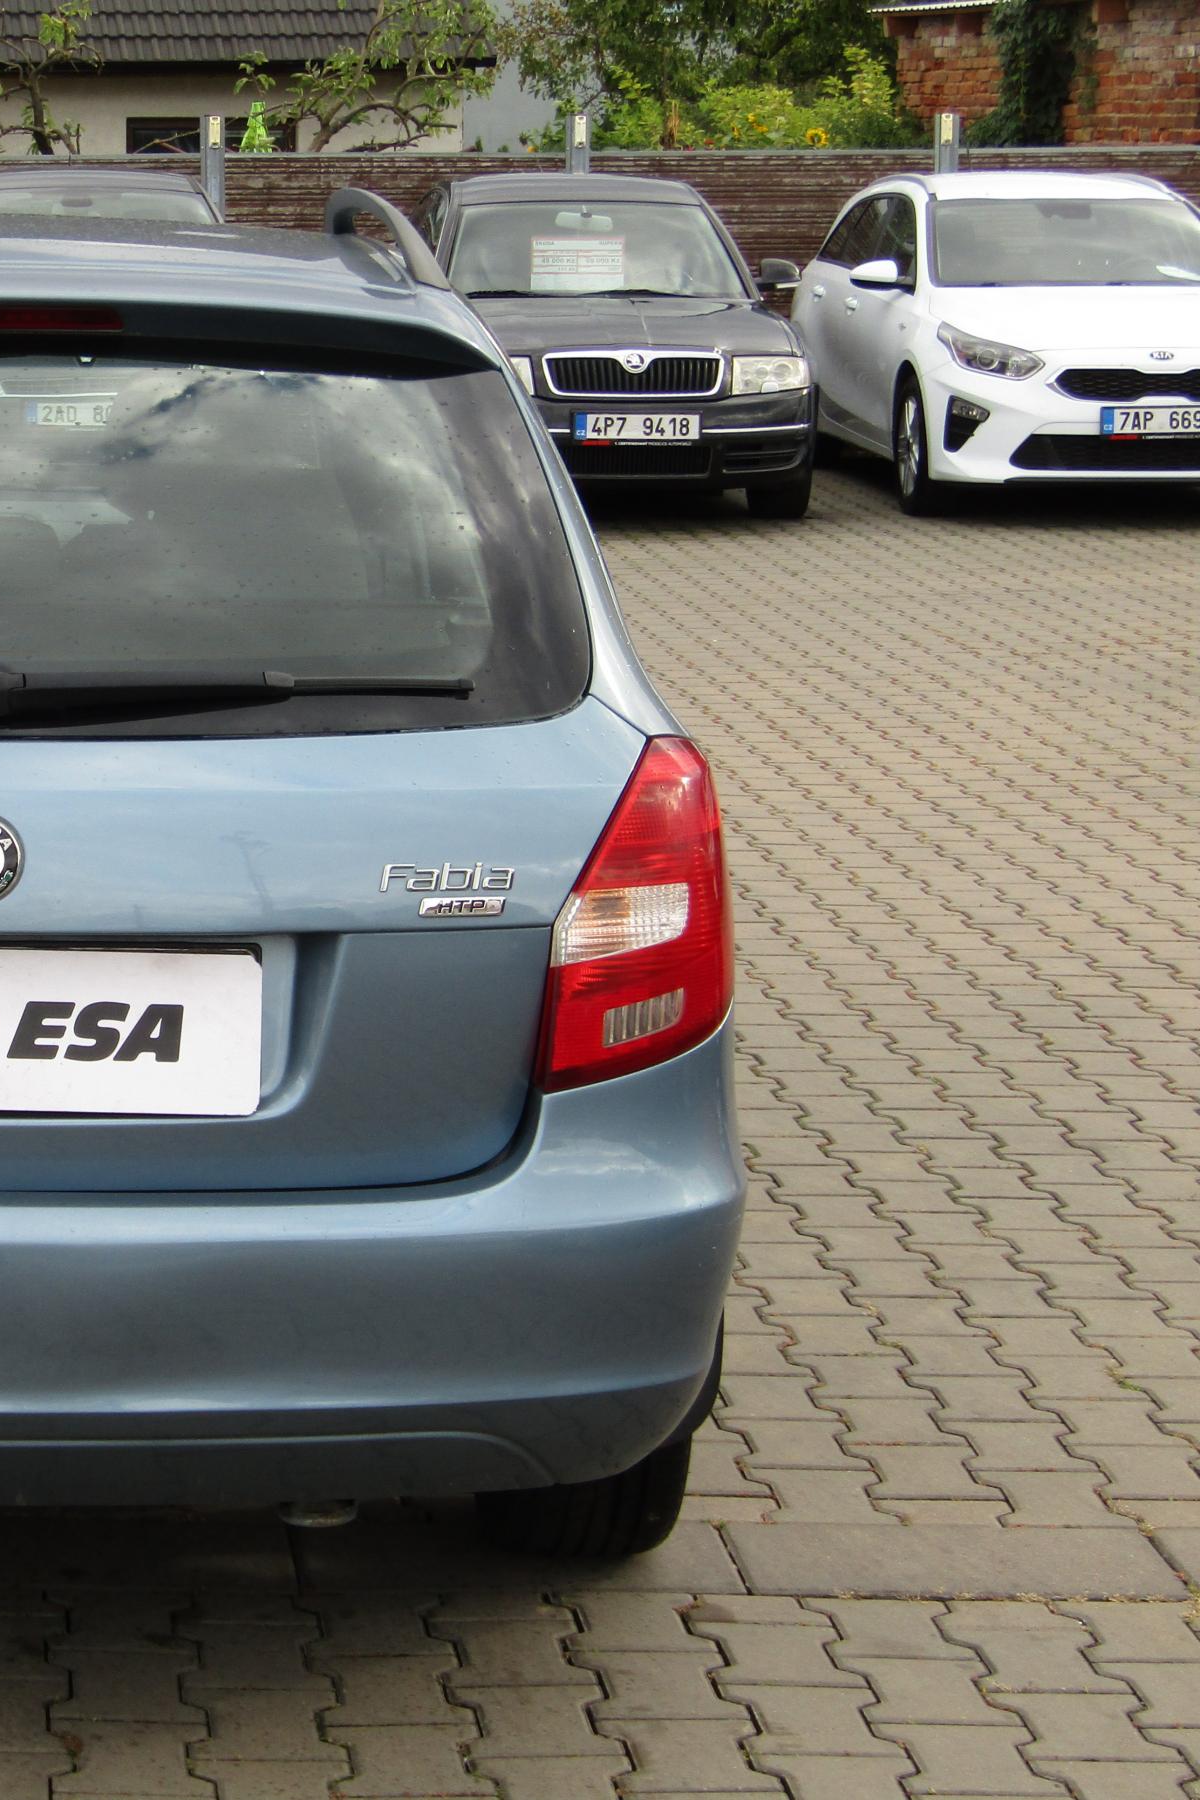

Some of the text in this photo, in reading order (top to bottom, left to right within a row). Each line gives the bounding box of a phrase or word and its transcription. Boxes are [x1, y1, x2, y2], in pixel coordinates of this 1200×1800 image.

[1152, 351, 1173, 360] KIA
[41, 405, 77, 423] 2AD
[1120, 411, 1154, 431] 7AP
[591, 417, 690, 436] 4P7 9418
[379, 862, 515, 892] Fabia
[437, 899, 485, 914] HTP
[6, 1001, 184, 1063] ESA
